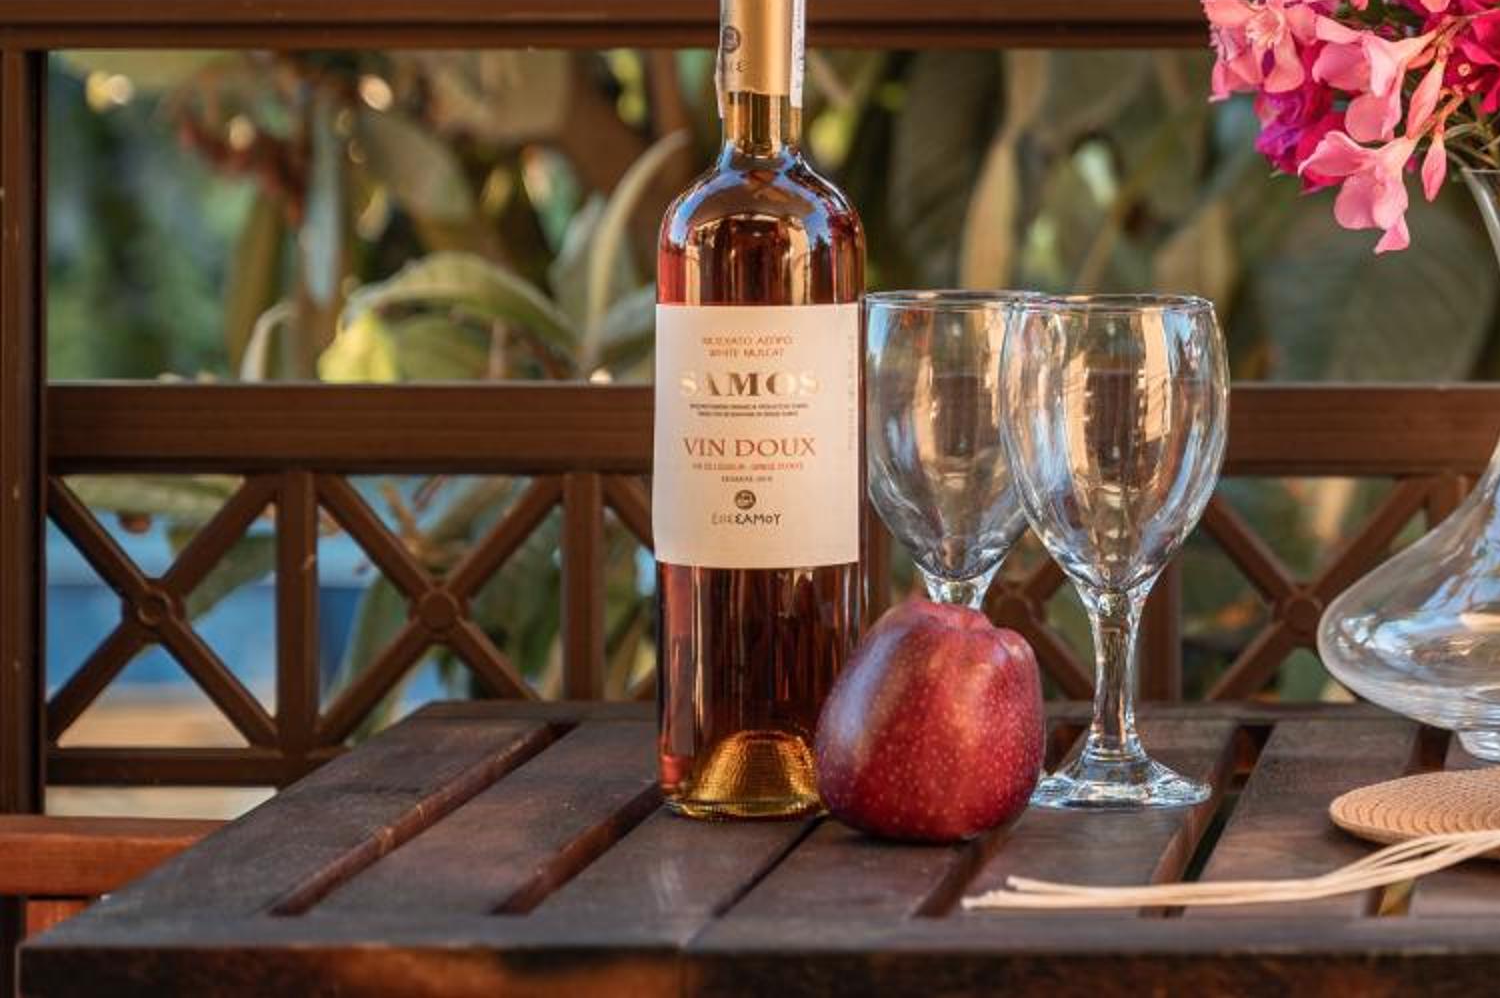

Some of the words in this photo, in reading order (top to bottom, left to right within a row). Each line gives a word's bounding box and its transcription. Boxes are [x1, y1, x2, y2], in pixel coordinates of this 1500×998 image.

[679, 370, 824, 397] SAMOS
[683, 437, 726, 457] VIN
[735, 437, 817, 457] DOUX
